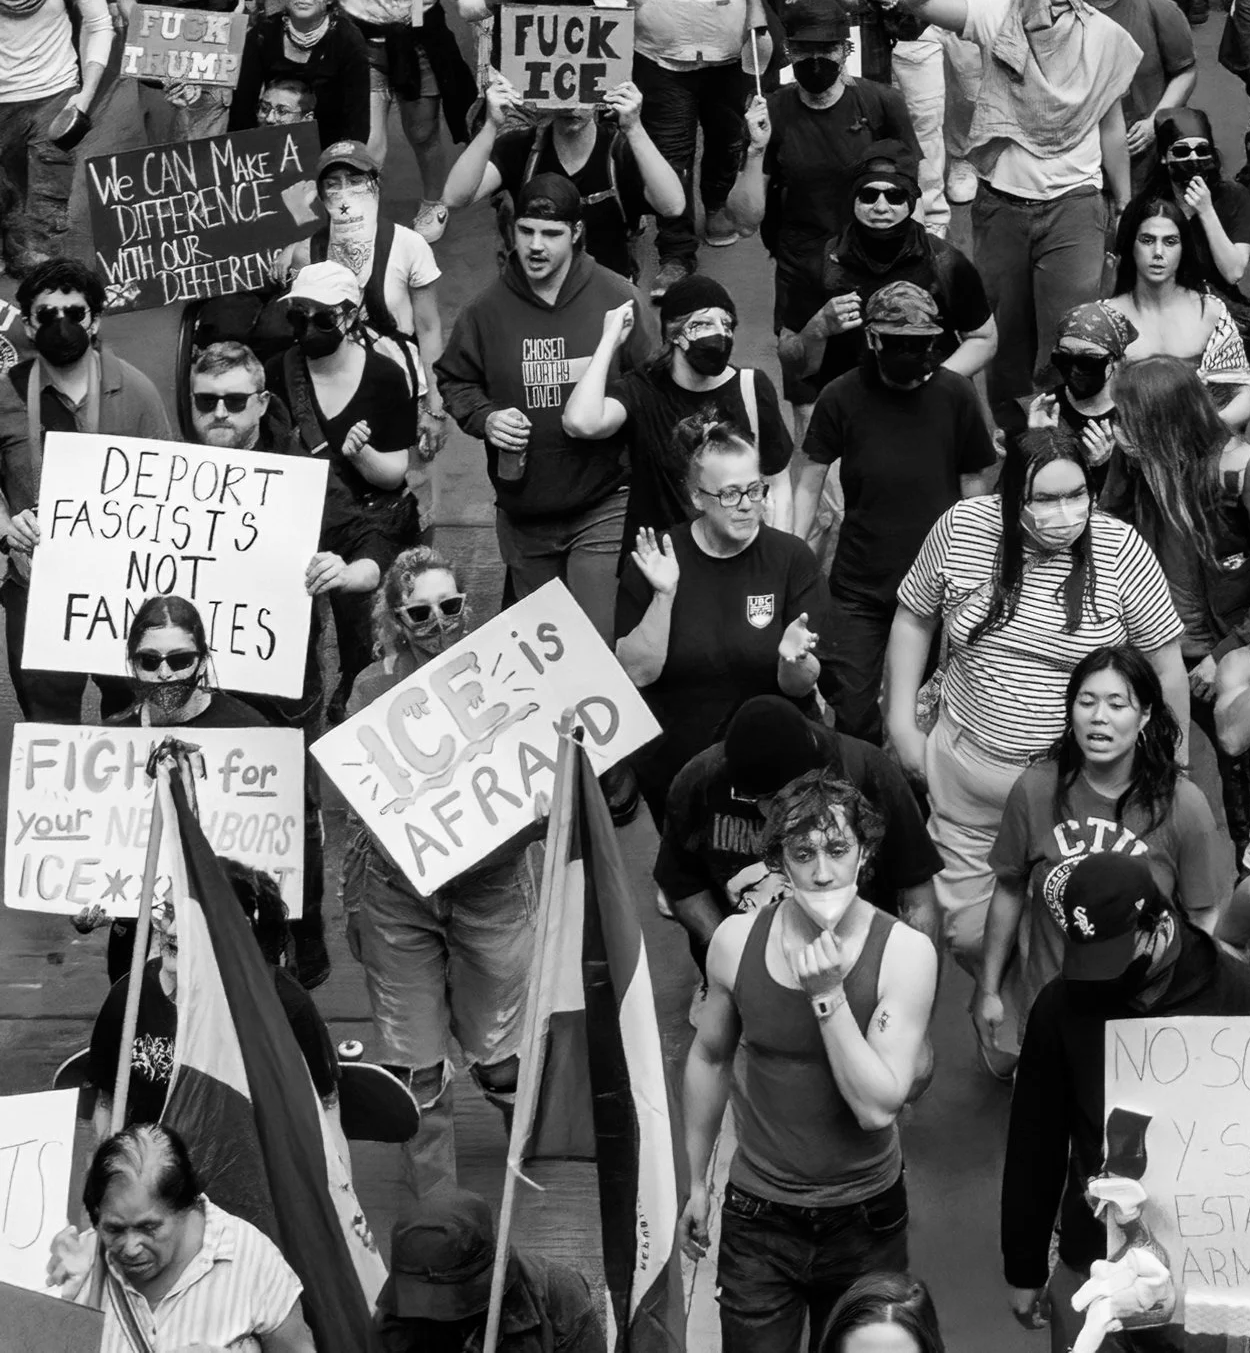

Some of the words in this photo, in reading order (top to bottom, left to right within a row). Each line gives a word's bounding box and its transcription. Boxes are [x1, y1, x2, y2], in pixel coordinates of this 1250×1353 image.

[139, 10, 231, 45] FUCK
[514, 13, 622, 61] FUCK
[124, 46, 238, 81] TRUMP
[522, 61, 609, 103] ICE
[89, 156, 135, 205] We
[143, 143, 198, 196] CAN
[279, 133, 303, 173] A
[110, 178, 278, 246] DIFFERENCE
[96, 244, 157, 285] WITH
[160, 235, 213, 271] OUR
[522, 337, 566, 362] CHOSEN
[523, 361, 571, 385] WORTHY
[526, 384, 561, 408] LOVED
[100, 446, 285, 506] DEPORT
[49, 499, 259, 553] FASCISTS
[126, 551, 217, 601] NOT
[355, 650, 487, 798] ICE
[510, 620, 566, 677] is
[14, 807, 93, 846] your
